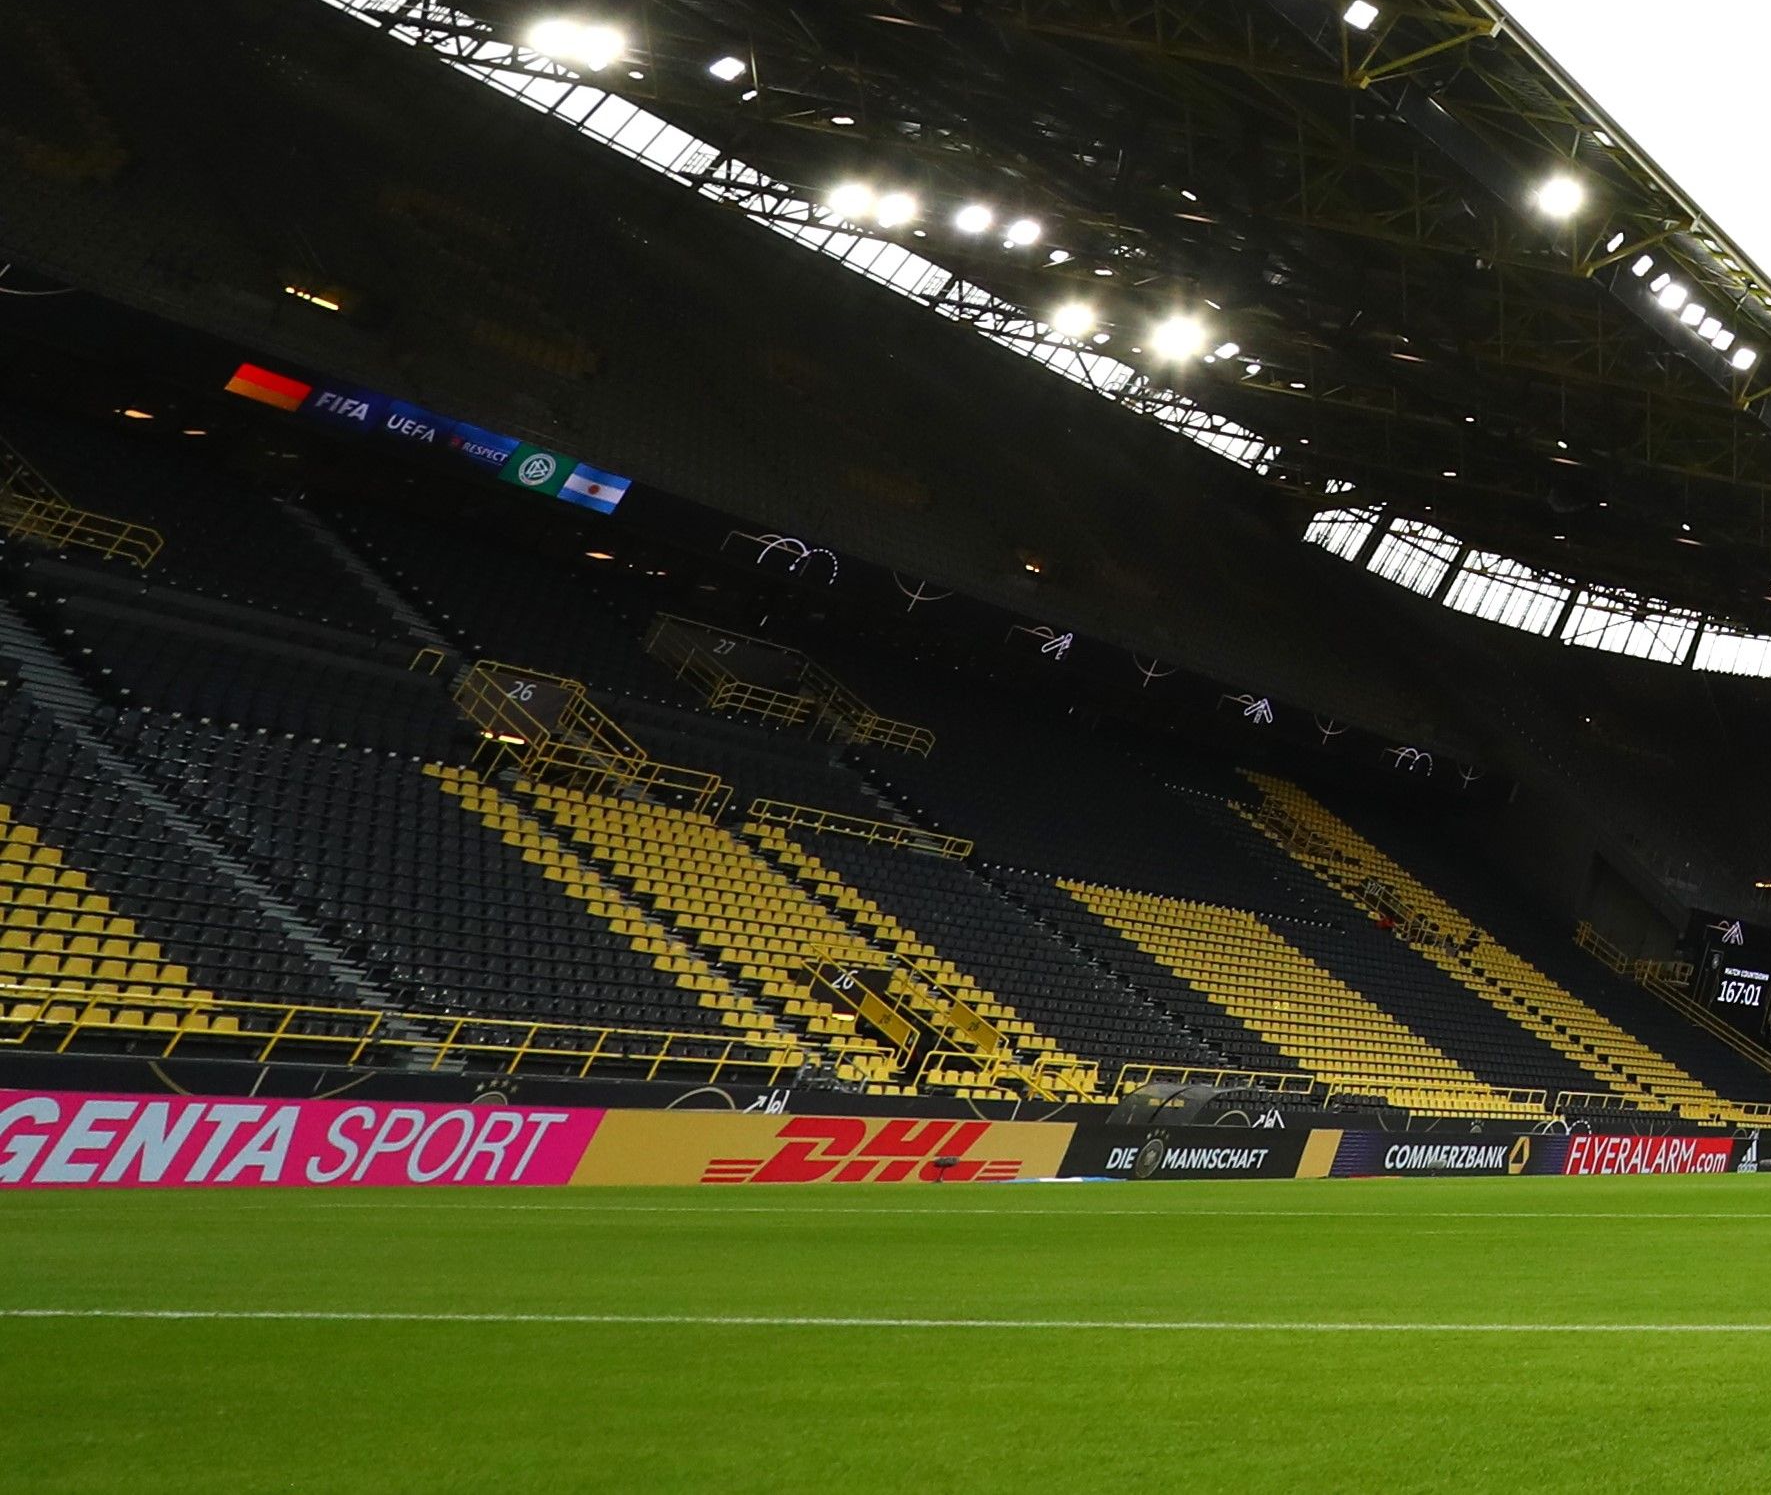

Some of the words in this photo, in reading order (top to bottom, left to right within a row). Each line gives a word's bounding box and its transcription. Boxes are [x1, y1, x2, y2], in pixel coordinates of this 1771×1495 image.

[315, 391, 371, 422] FIFA
[387, 413, 436, 443] UEFA
[462, 440, 509, 463] RESPECT
[713, 638, 736, 656] 27
[508, 680, 537, 702] 26
[832, 970, 859, 990] 26
[1717, 980, 1762, 1006] 167:01
[307, 1106, 568, 1183] SPORT
[750, 1117, 992, 1183] DHL
[1566, 1136, 1726, 1175] FLYERALARM.com
[1105, 1147, 1138, 1170] DIE
[1161, 1148, 1268, 1170] MANNSCHAFT
[1384, 1145, 1507, 1170] COMMERZBANK
